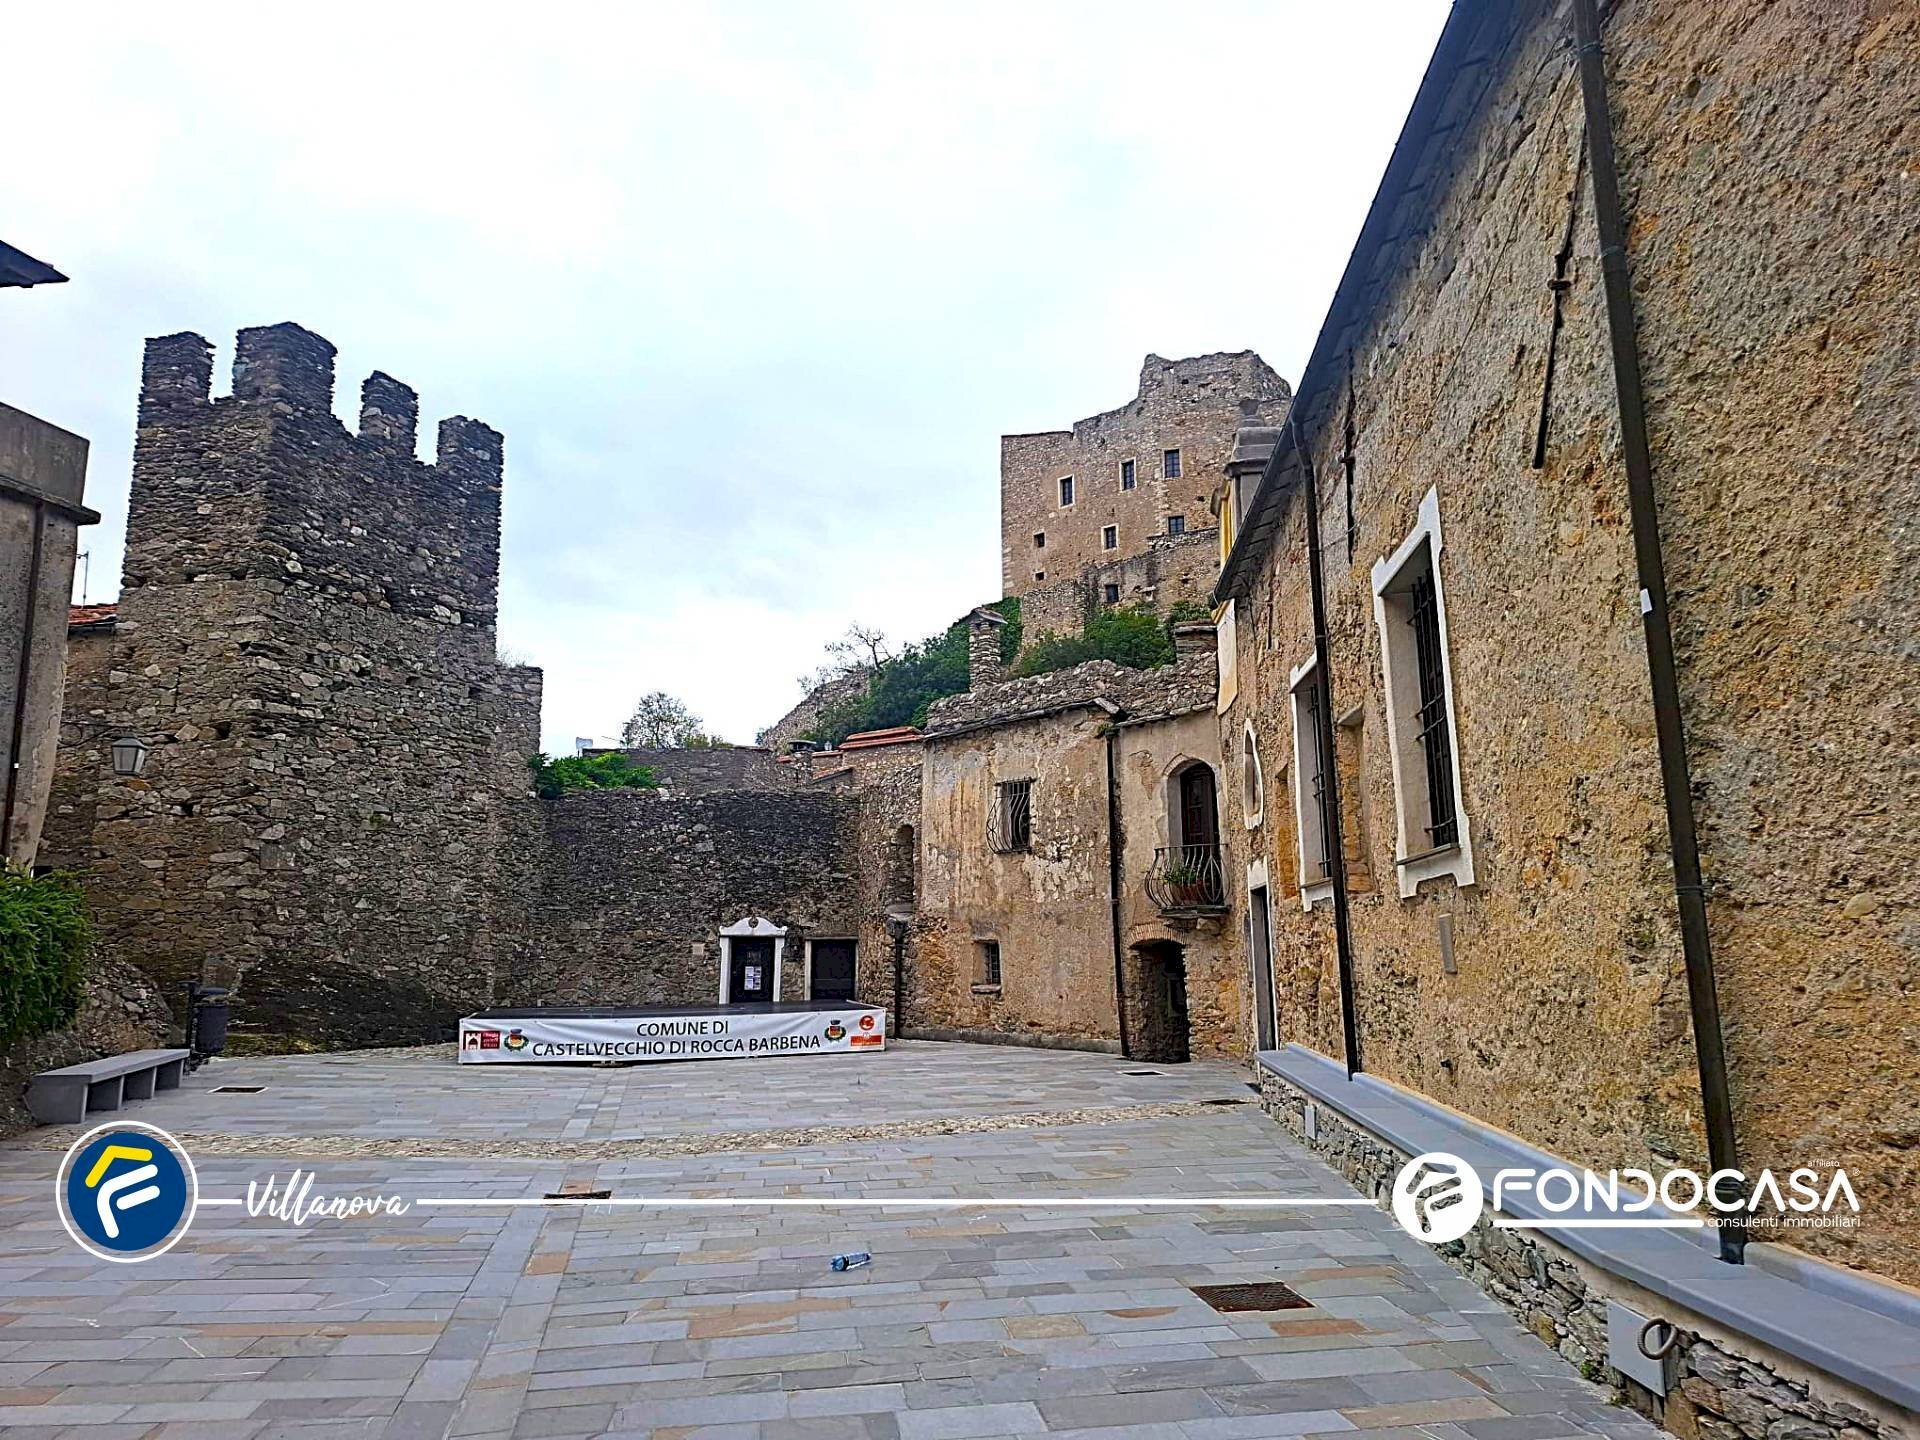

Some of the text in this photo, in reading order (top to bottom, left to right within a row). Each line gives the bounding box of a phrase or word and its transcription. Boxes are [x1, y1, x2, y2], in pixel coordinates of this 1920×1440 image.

[636, 1020, 729, 1037] COMUNE DI
[532, 1035, 821, 1057] CASTELVECCHIO DI ROCCA BARBENA
